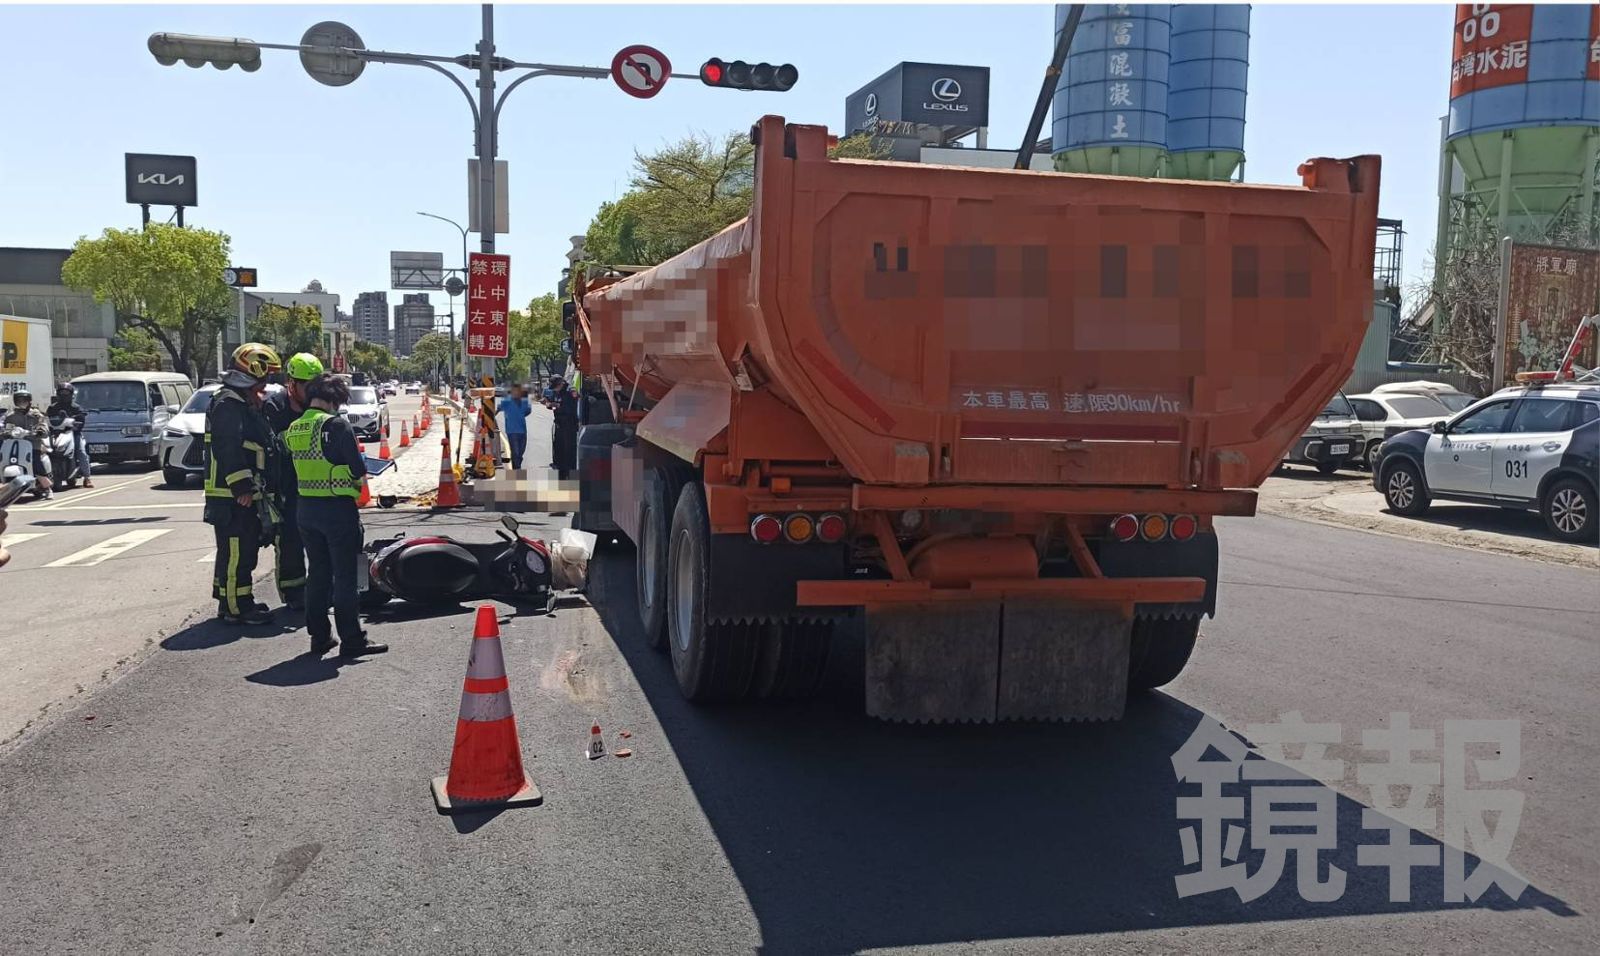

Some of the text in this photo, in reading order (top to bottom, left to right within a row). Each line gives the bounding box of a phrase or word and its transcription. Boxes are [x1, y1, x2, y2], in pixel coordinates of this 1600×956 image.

[923, 102, 969, 112] LEXUS
[137, 172, 185, 186] KIA
[469, 259, 488, 351] 禁止左轉
[488, 260, 508, 352] 環中東路
[962, 391, 1050, 411] 本車最高
[1505, 460, 1529, 479] 031
[593, 740, 604, 754] 02
